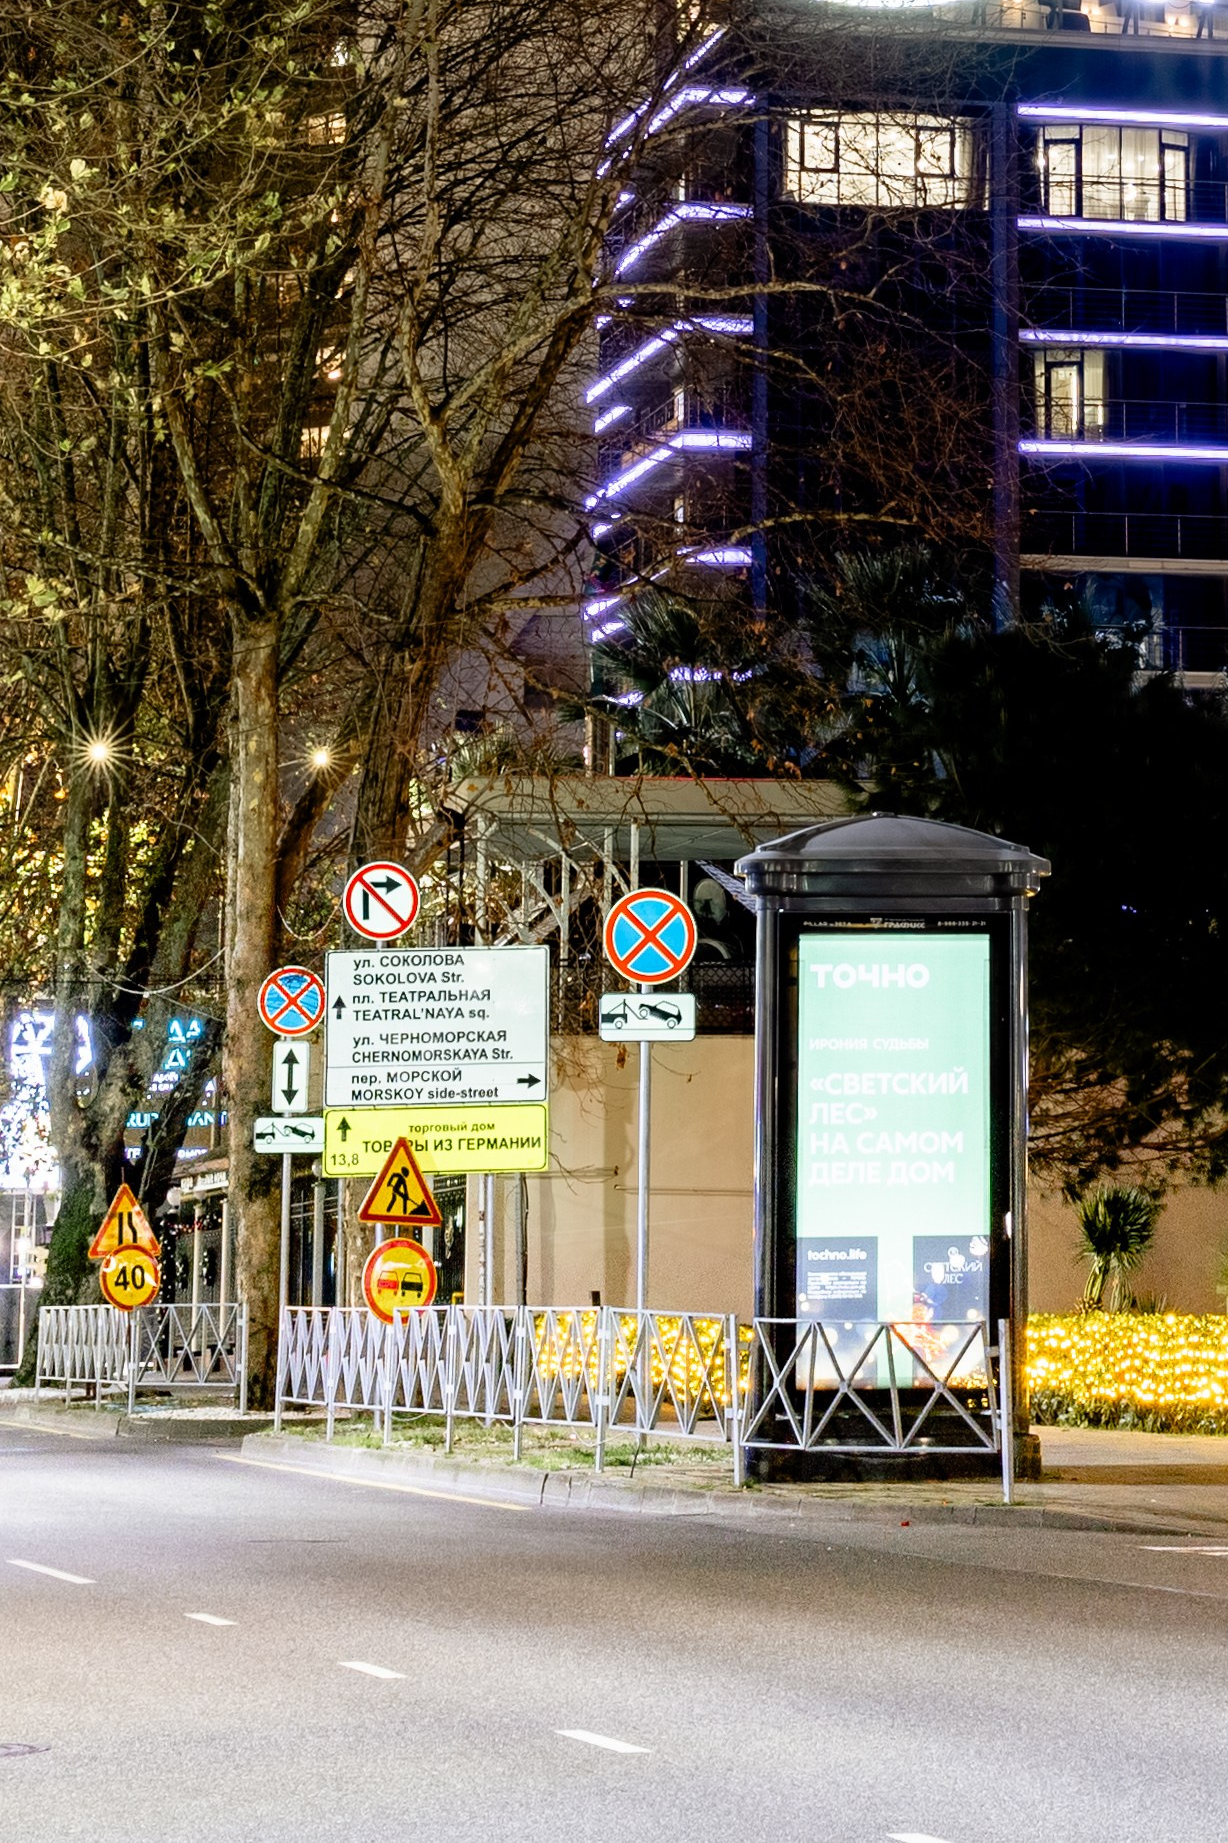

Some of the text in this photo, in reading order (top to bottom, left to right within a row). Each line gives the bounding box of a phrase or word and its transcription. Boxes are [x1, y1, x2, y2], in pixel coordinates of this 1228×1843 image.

[353, 954, 464, 971] ул. СОКОЛОВА
[353, 971, 464, 986] SOKOLOVA Str.
[810, 963, 930, 989] ТОЧНО
[352, 989, 491, 1005] пл. ТЕАТРАЛЬНАЯ
[353, 1007, 490, 1021] TEATRAL'NAYA sq.
[353, 1030, 507, 1048] ул. ЧЕРНОМОРСКАЯ
[809, 1037, 929, 1051] ИРОНИЯ СУДЬБЫ
[352, 1047, 513, 1063] CHERNOMORSKAYA Str.
[351, 1068, 462, 1087] пер. МОРСКОЙ
[809, 1066, 969, 1096] «СВЕТСКИЙ
[351, 1087, 499, 1101] MORSKOY side-street
[808, 1102, 878, 1125] ЛЕС»
[408, 1122, 495, 1135] торговый дом
[362, 1137, 541, 1154] ТОВЫ ИЗ ГЕРМАНИИ
[810, 1131, 964, 1154] НА САМОМ
[330, 1154, 359, 1167] 13,8
[808, 1161, 955, 1187] ДЕЛЕ ДОМ
[807, 1248, 867, 1261] tochno.life
[923, 1259, 983, 1273] СТСКИЙ
[114, 1264, 145, 1291] 40
[943, 1273, 964, 1284] ЛЕС
